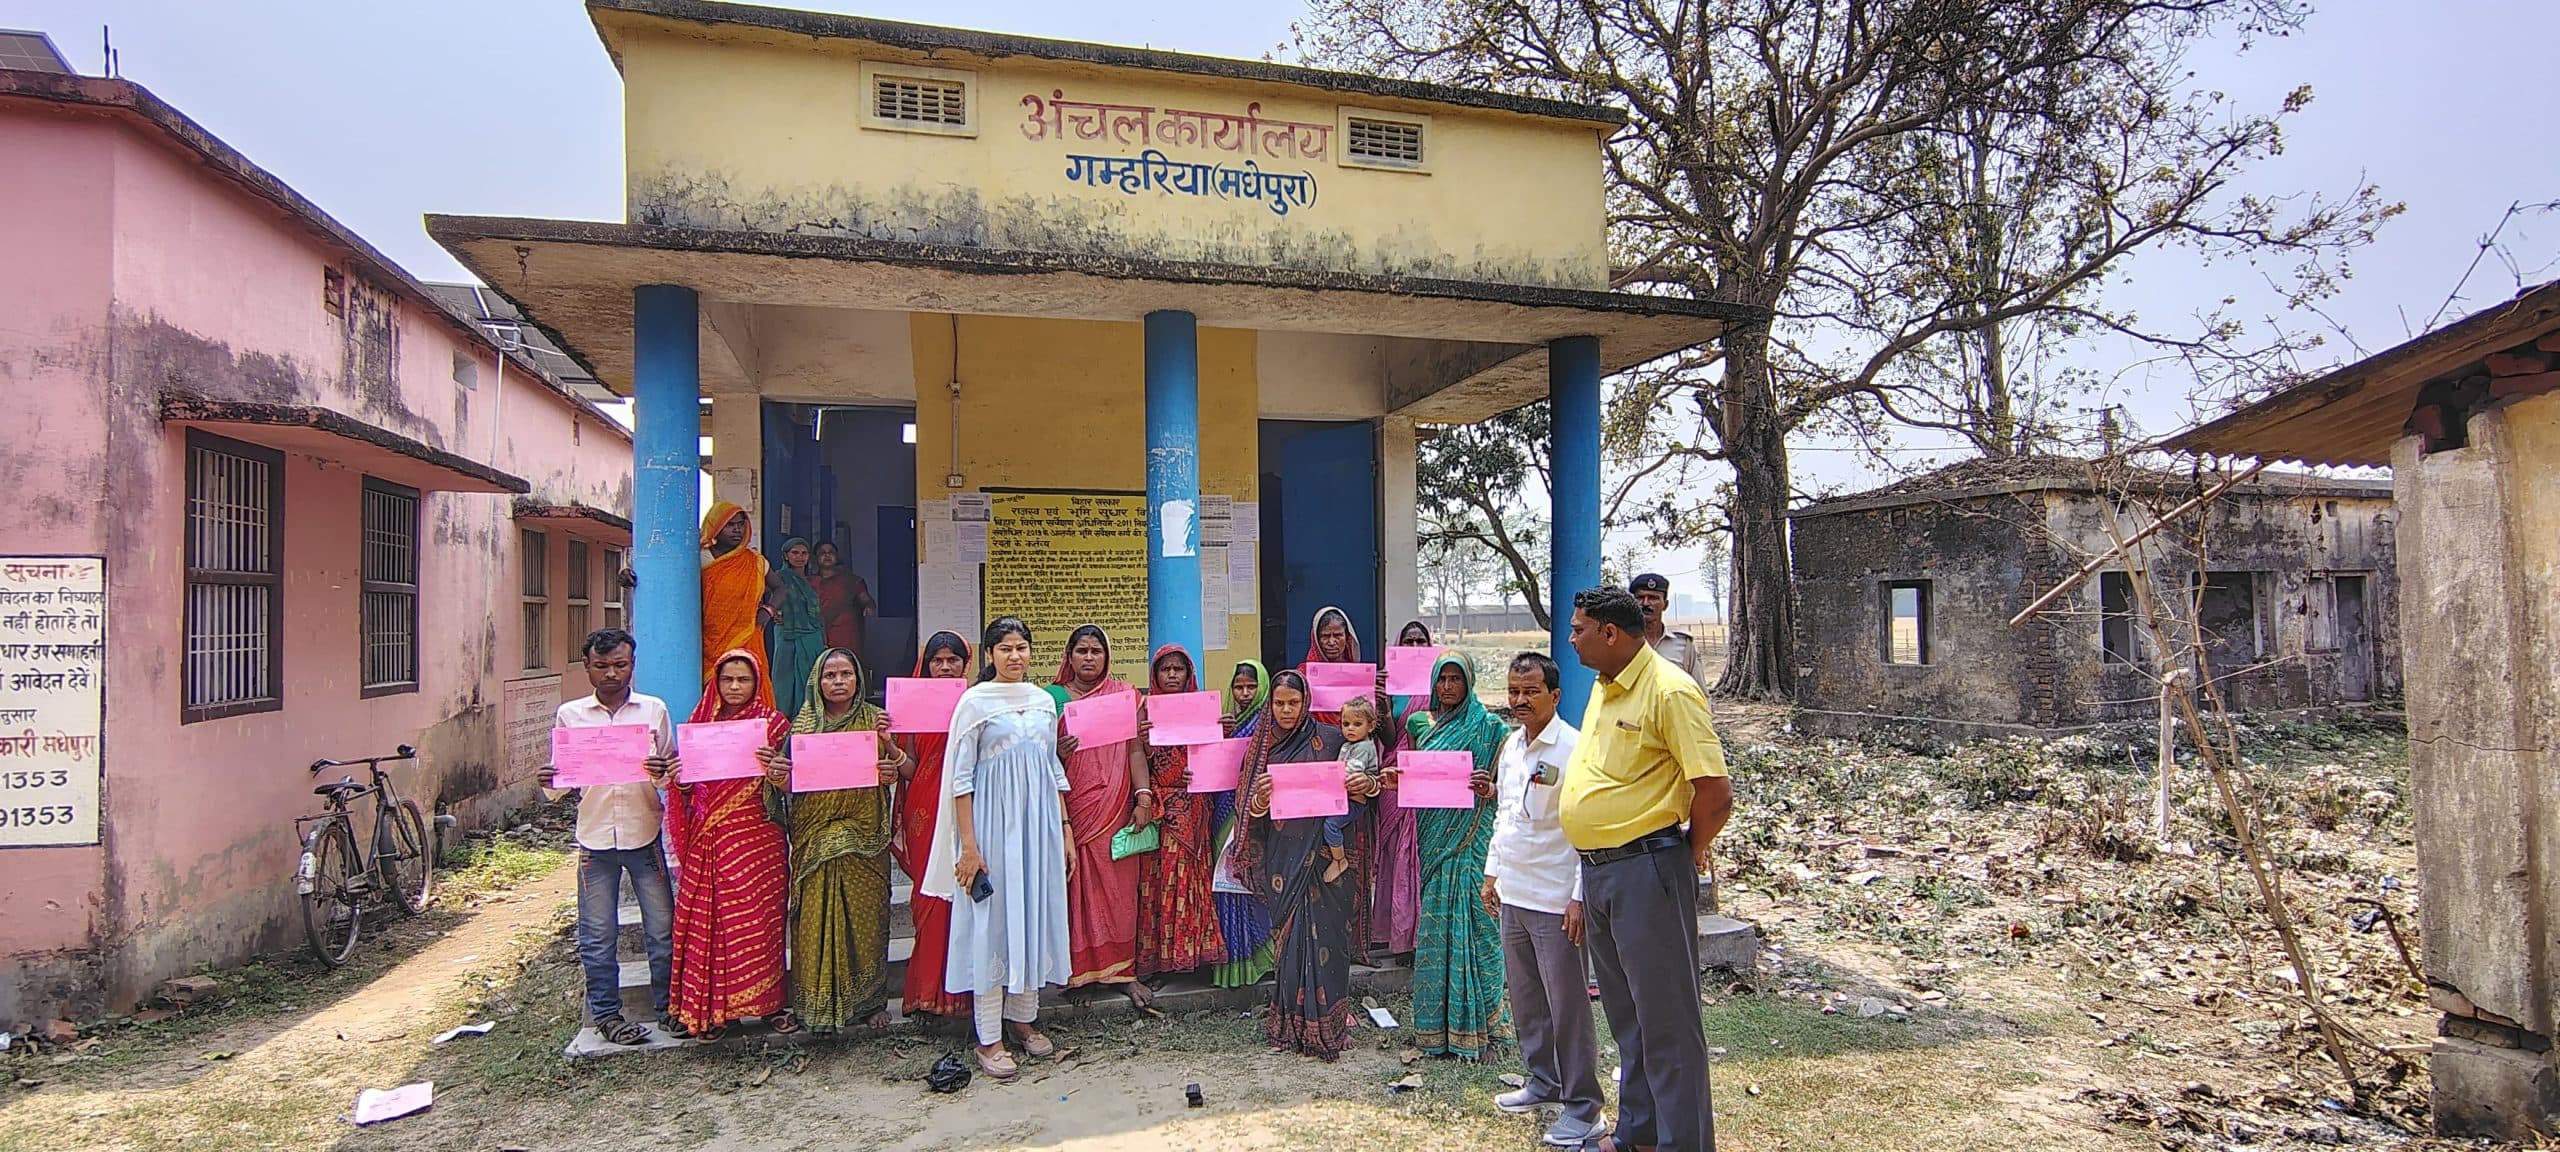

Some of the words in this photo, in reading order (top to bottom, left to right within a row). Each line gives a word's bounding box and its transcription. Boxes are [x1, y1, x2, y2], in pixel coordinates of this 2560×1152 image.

[1019, 89, 1155, 145] अंचल
[1156, 102, 1334, 162] कार्यालय
[1011, 507, 1041, 518] राजस्व
[1044, 506, 1060, 516] एवं
[1067, 506, 1092, 519] भूमि
[1098, 508, 1129, 520] सुधार
[4, 564, 70, 583] सूचना
[0, 587, 33, 607] वेदन
[33, 591, 54, 604] का
[3, 611, 32, 634] नहीं
[35, 609, 66, 634] होता
[62, 607, 80, 634] है
[81, 609, 100, 632] तो
[10, 668, 65, 694] आवेदन
[0, 708, 37, 725] नुसार
[0, 728, 39, 758] कारी
[43, 729, 96, 761] मधेपुरा
[2, 770, 68, 790] 1353
